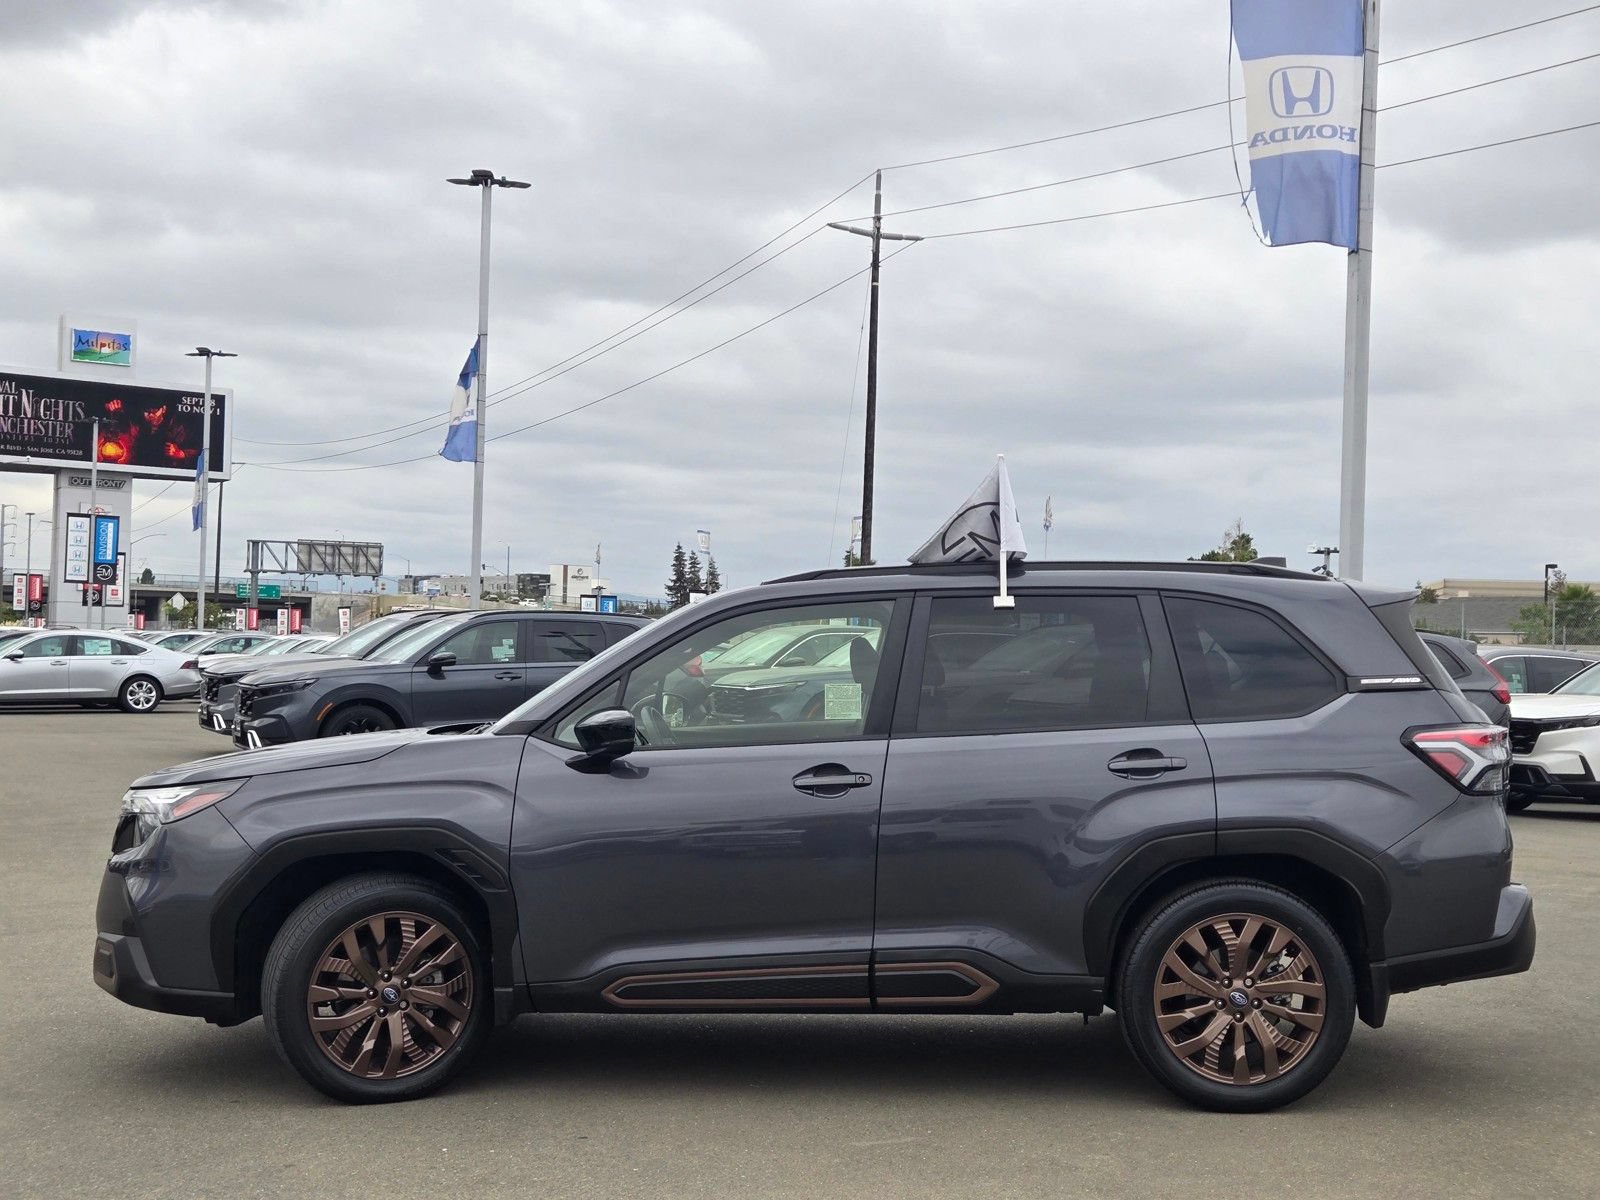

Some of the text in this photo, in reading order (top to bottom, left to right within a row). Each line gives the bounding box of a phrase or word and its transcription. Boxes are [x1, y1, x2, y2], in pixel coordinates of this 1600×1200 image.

[75, 333, 128, 354] Milpitas
[181, 396, 204, 405] SEPT
[176, 404, 191, 413] TO
[98, 521, 108, 560] ENVISION
